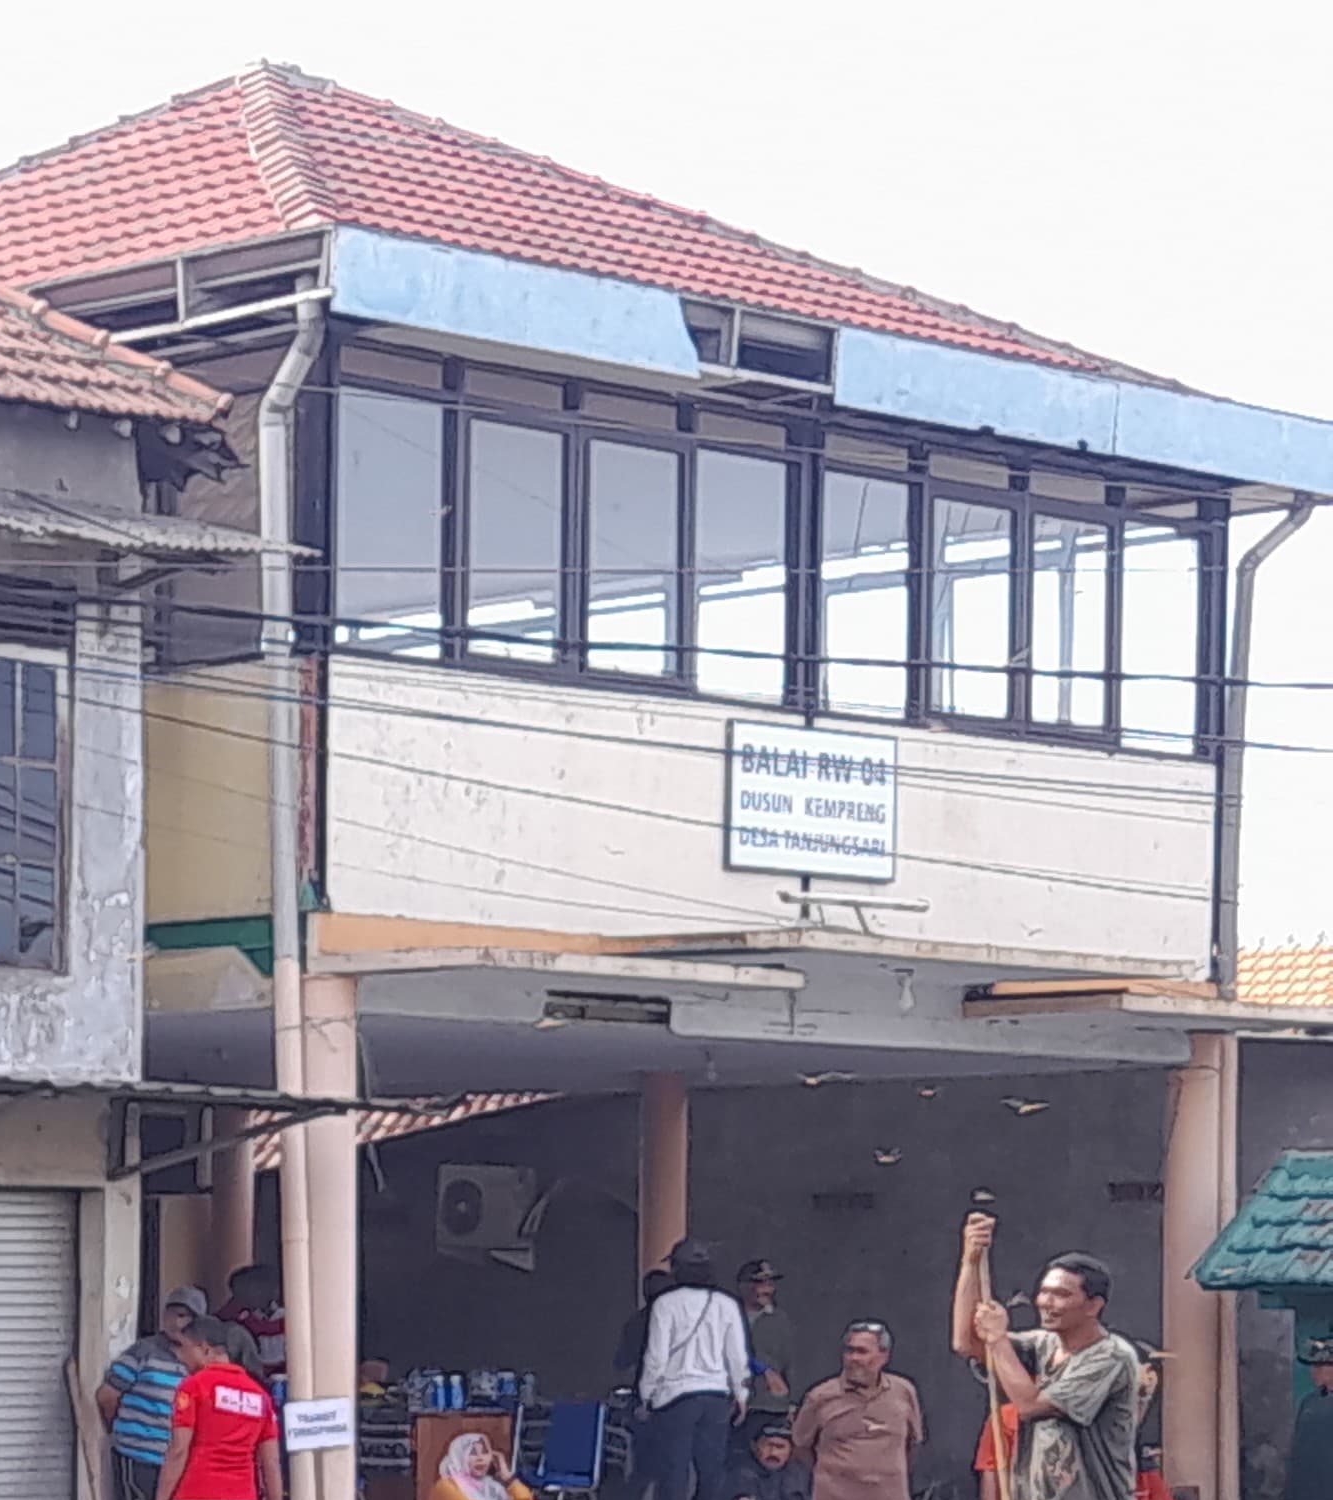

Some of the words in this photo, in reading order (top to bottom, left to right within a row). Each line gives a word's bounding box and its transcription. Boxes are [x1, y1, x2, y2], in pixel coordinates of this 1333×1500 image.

[741, 743, 808, 779] BALAI
[817, 751, 854, 783] RW
[861, 757, 887, 786] 04
[739, 789, 794, 815] DUSUN
[803, 795, 887, 825] KEMPRENG
[738, 825, 780, 848] DESA
